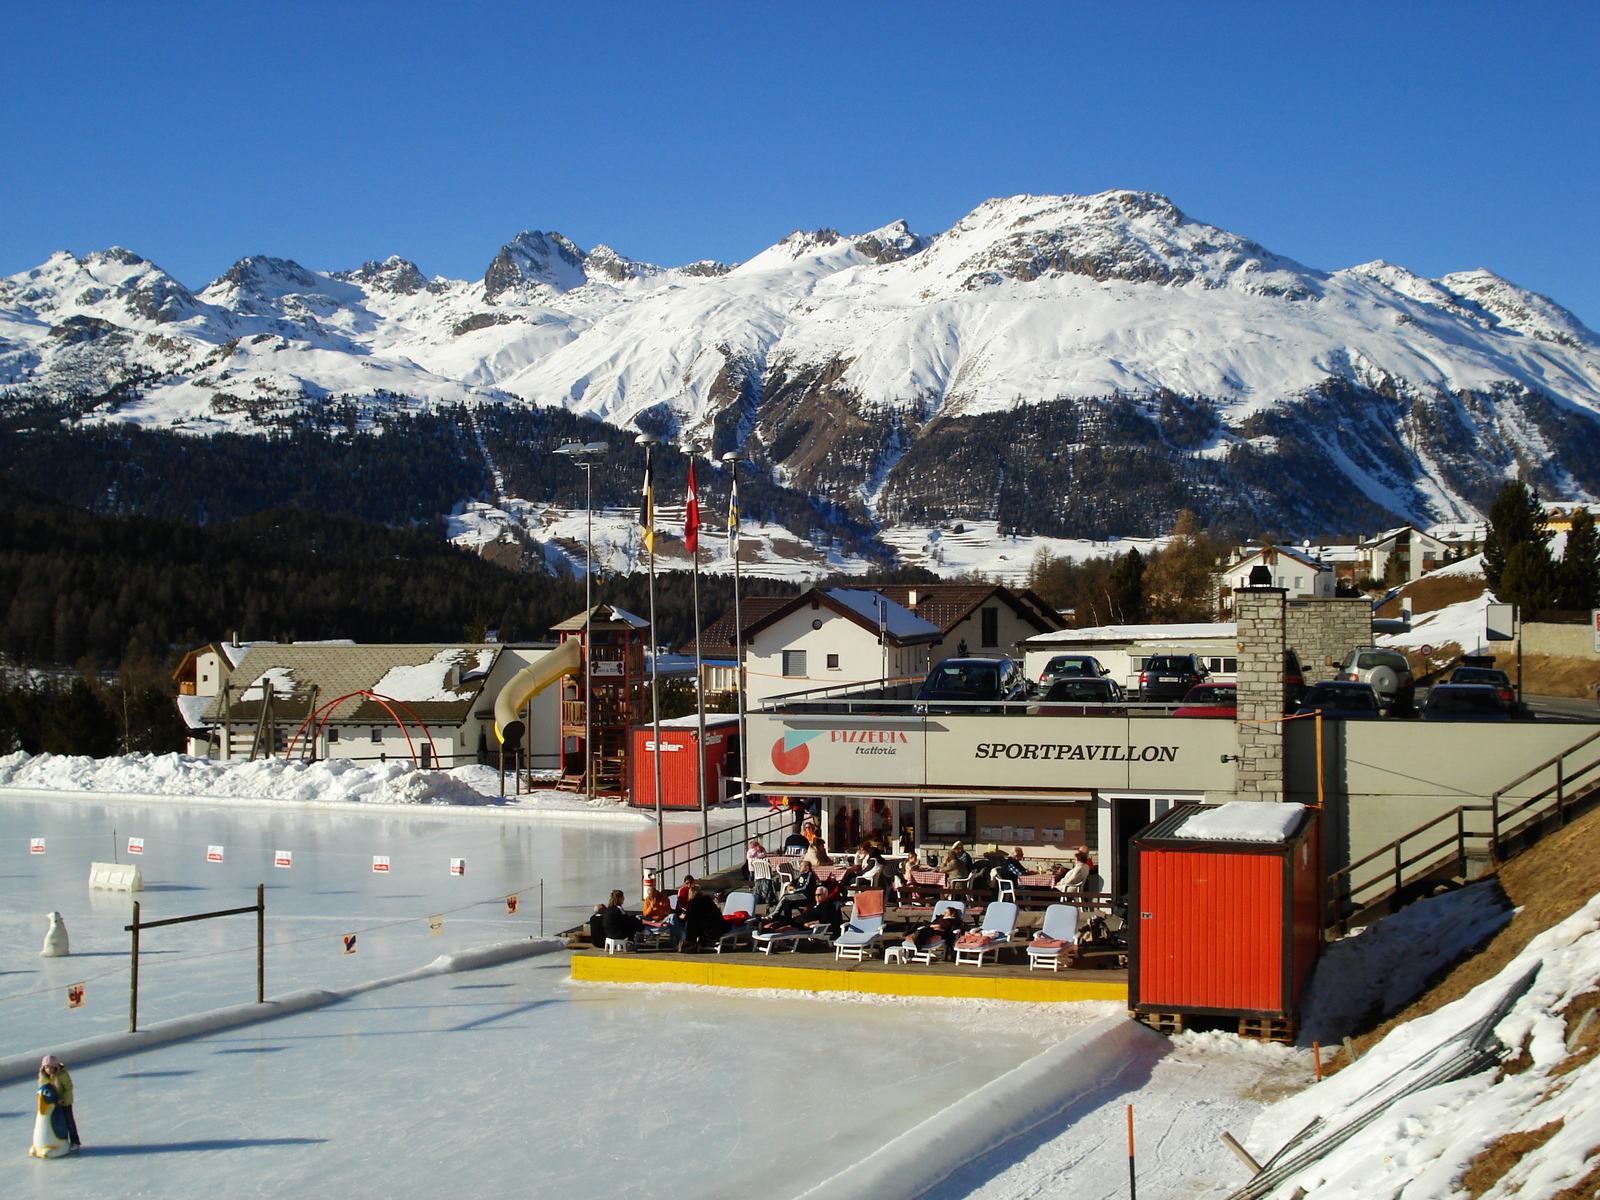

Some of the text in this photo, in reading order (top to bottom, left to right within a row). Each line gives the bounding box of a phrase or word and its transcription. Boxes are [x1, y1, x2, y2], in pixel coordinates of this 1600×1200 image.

[831, 730, 908, 744] PIZZERIA
[855, 746, 897, 755] trattoria
[975, 743, 1179, 762] SPORTPAVILLON
